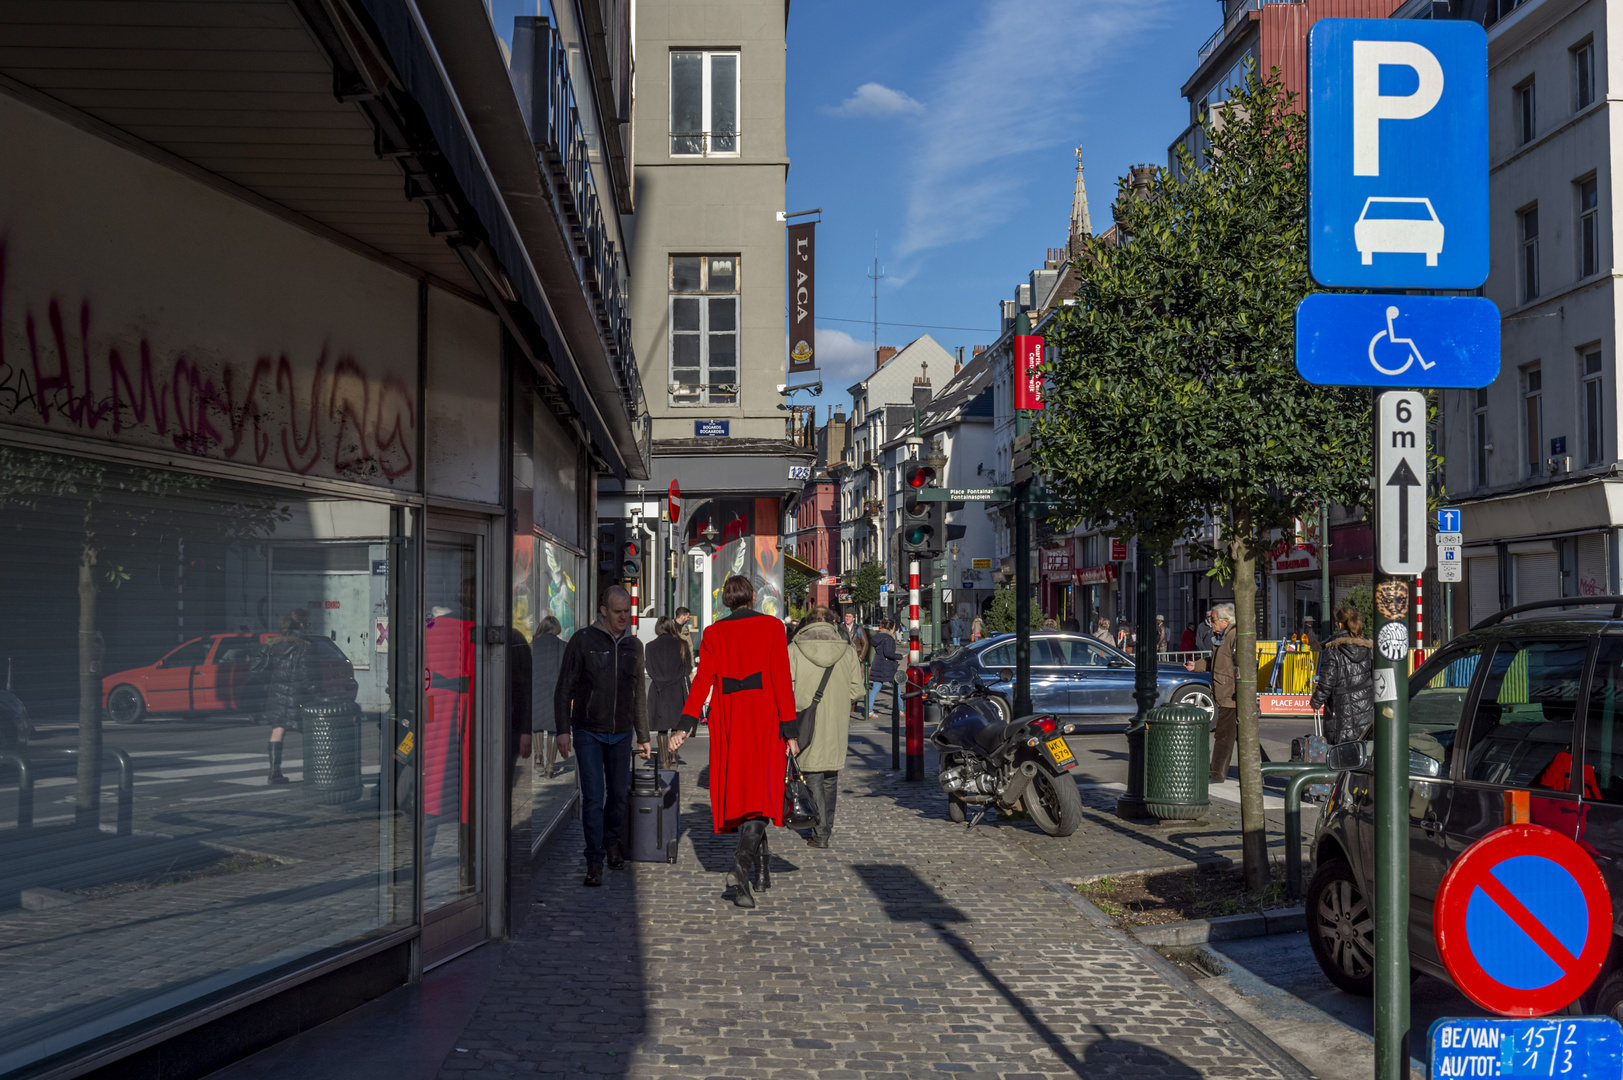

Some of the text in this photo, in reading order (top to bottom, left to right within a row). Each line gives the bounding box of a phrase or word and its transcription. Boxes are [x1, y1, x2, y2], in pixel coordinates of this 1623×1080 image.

[1353, 40, 1444, 177] P
[796, 269, 809, 324] ACA
[1396, 399, 1412, 424] 6
[1392, 430, 1416, 448] m
[1054, 749, 1070, 760] 579
[1441, 1027, 1506, 1049] DE/VAN:
[1440, 1056, 1501, 1076] AU/TOT:
